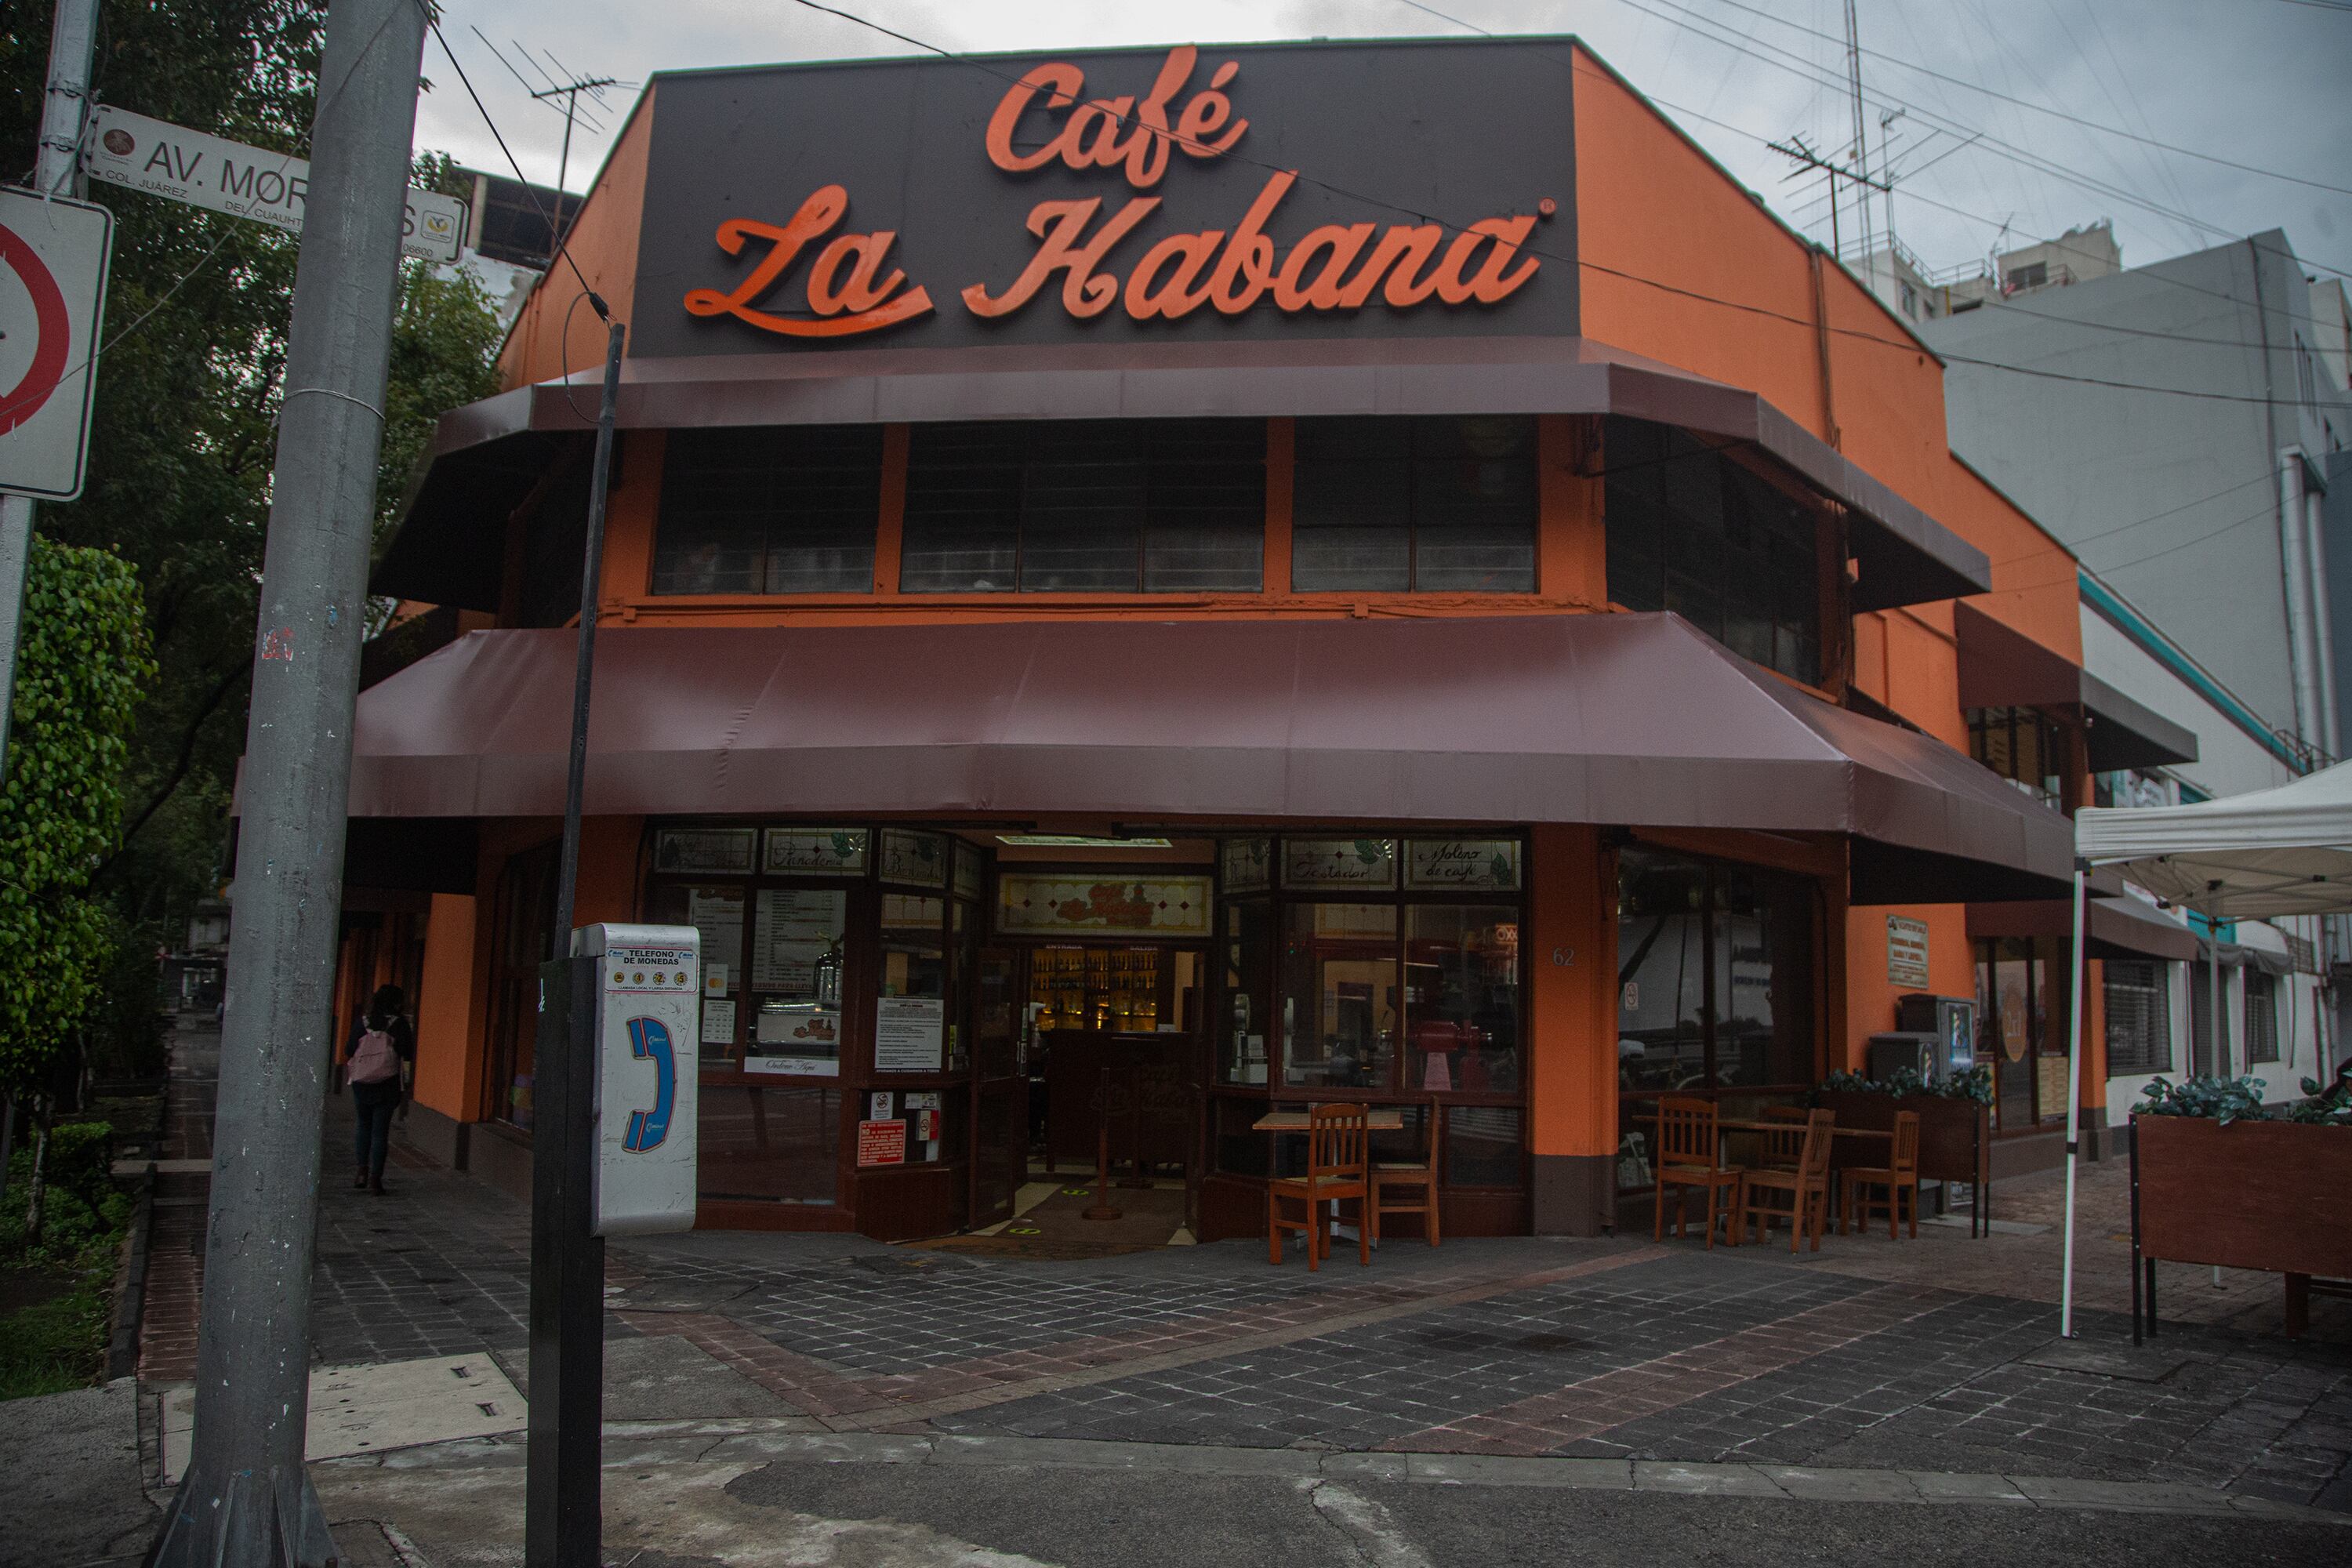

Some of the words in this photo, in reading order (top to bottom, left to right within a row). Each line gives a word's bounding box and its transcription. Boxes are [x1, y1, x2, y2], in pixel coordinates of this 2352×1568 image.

[986, 45, 1249, 188] Café
[144, 141, 203, 187] AV.
[106, 169, 135, 185] COL.
[138, 179, 188, 198] JUÁREZ
[225, 200, 251, 215] DEL.
[254, 206, 303, 227] CUAUHT
[684, 184, 935, 337] La
[961, 170, 1541, 320] Habana
[629, 949, 674, 958] TELEFONO
[1553, 947, 1574, 966] 62
